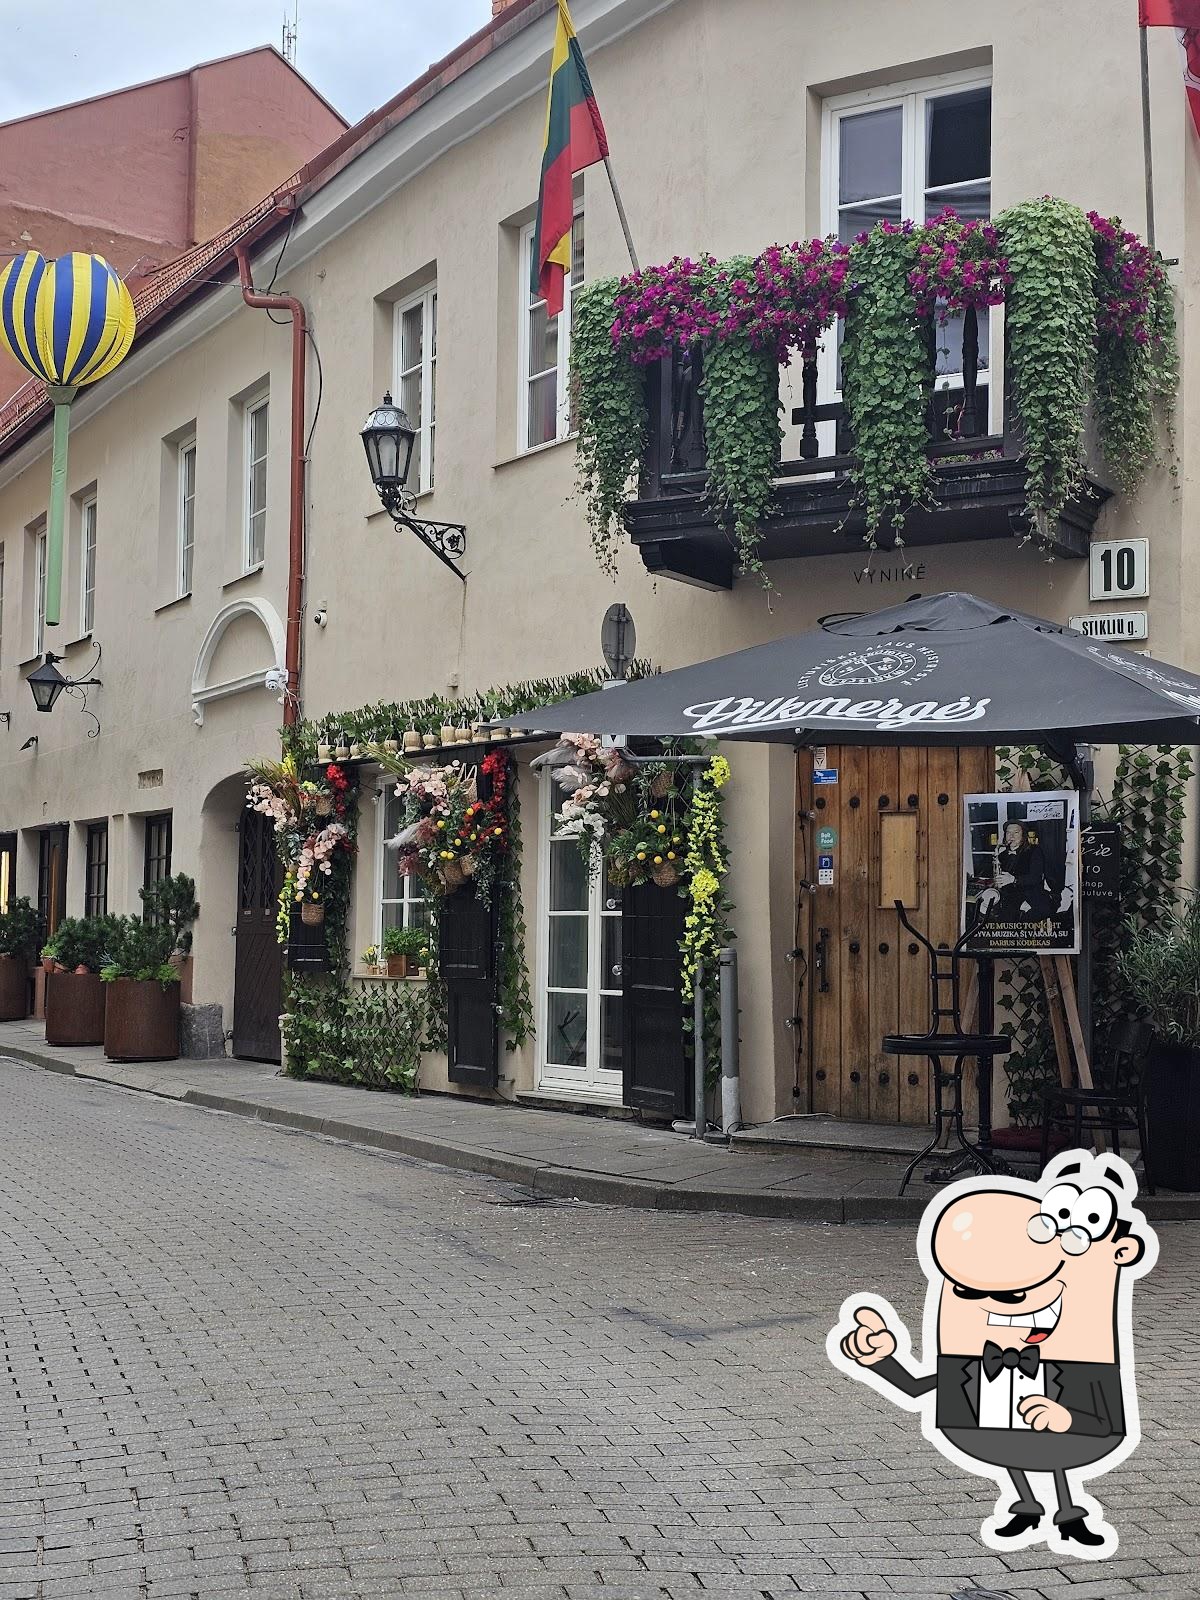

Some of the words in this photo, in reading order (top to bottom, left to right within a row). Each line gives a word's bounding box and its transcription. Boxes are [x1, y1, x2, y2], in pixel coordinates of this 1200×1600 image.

[853, 563, 926, 584] VYNINĖ
[1100, 547, 1135, 592] 10
[1127, 620, 1138, 636] g.
[682, 696, 992, 730] Vilkmergės
[996, 922, 1022, 930] MUSIC
[1023, 921, 1062, 930] TONIGHT
[989, 939, 1016, 947] DARIUS
